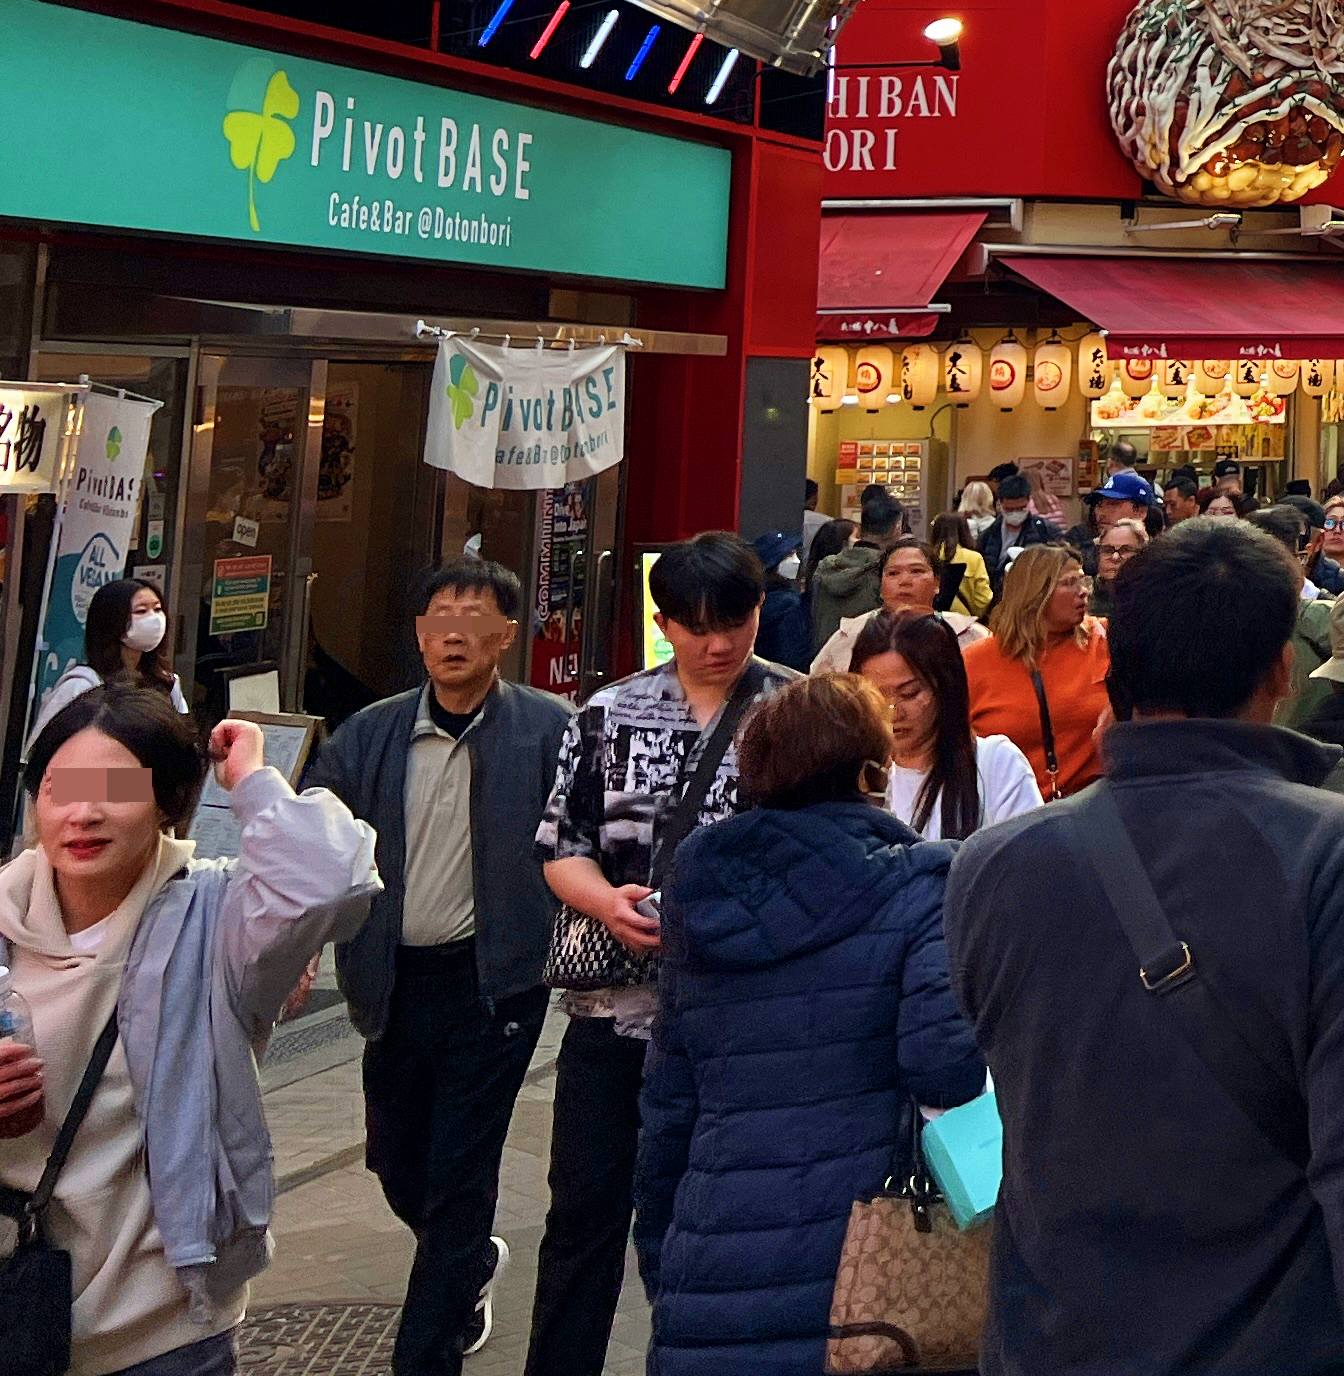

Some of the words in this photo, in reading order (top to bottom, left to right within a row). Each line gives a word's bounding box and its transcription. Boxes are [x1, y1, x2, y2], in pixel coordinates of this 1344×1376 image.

[311, 90, 426, 182] Pivot
[439, 116, 534, 202] BASE
[328, 191, 413, 238] Cafe&Bar
[417, 206, 512, 249] @Dotonbori
[481, 381, 556, 432] Pivot
